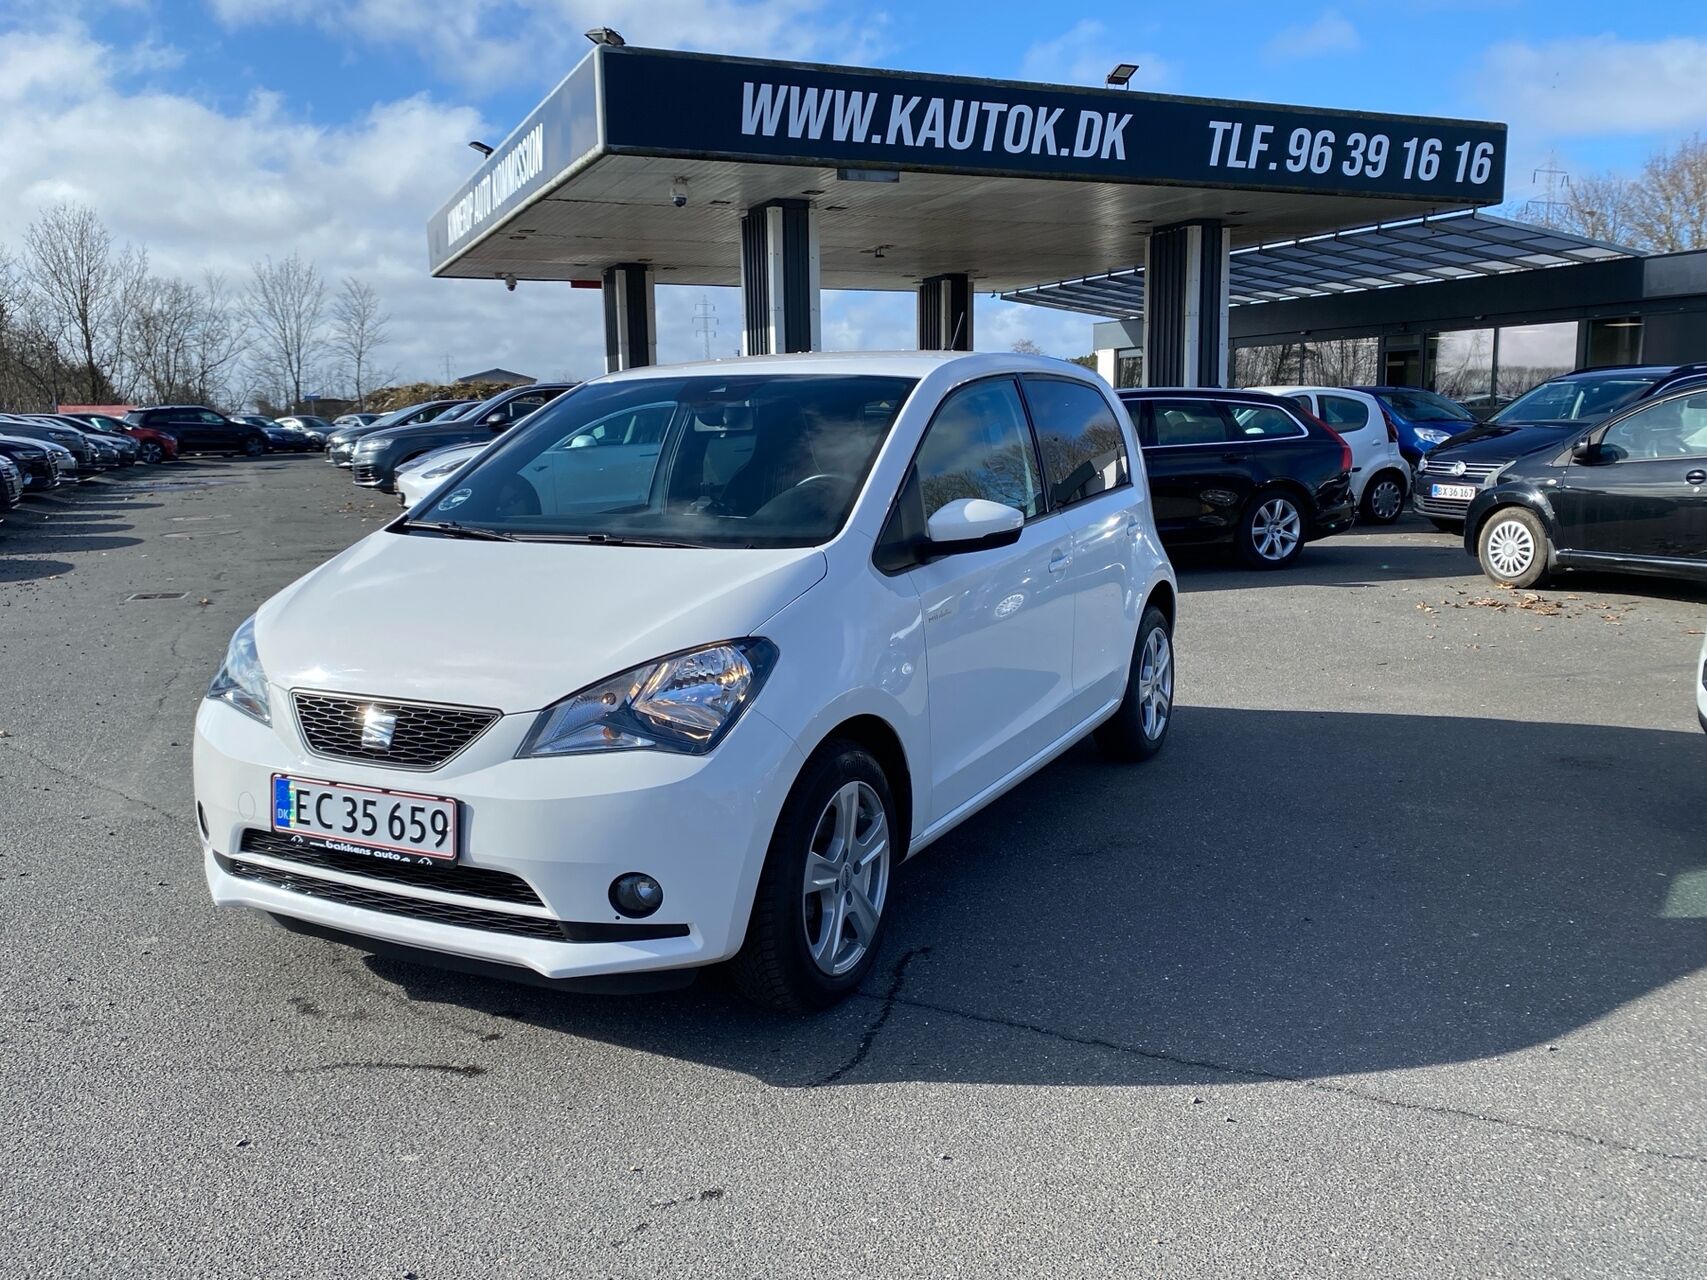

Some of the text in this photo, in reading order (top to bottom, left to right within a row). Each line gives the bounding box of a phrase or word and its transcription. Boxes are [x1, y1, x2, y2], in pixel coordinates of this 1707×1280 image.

[741, 82, 1133, 160] WWW.KAUTOK.DK
[1209, 120, 1494, 185] TLF. 96 39 16 16
[277, 808, 289, 820] DK
[295, 788, 448, 848] EC 35 659
[325, 840, 400, 861] bakkens auto
